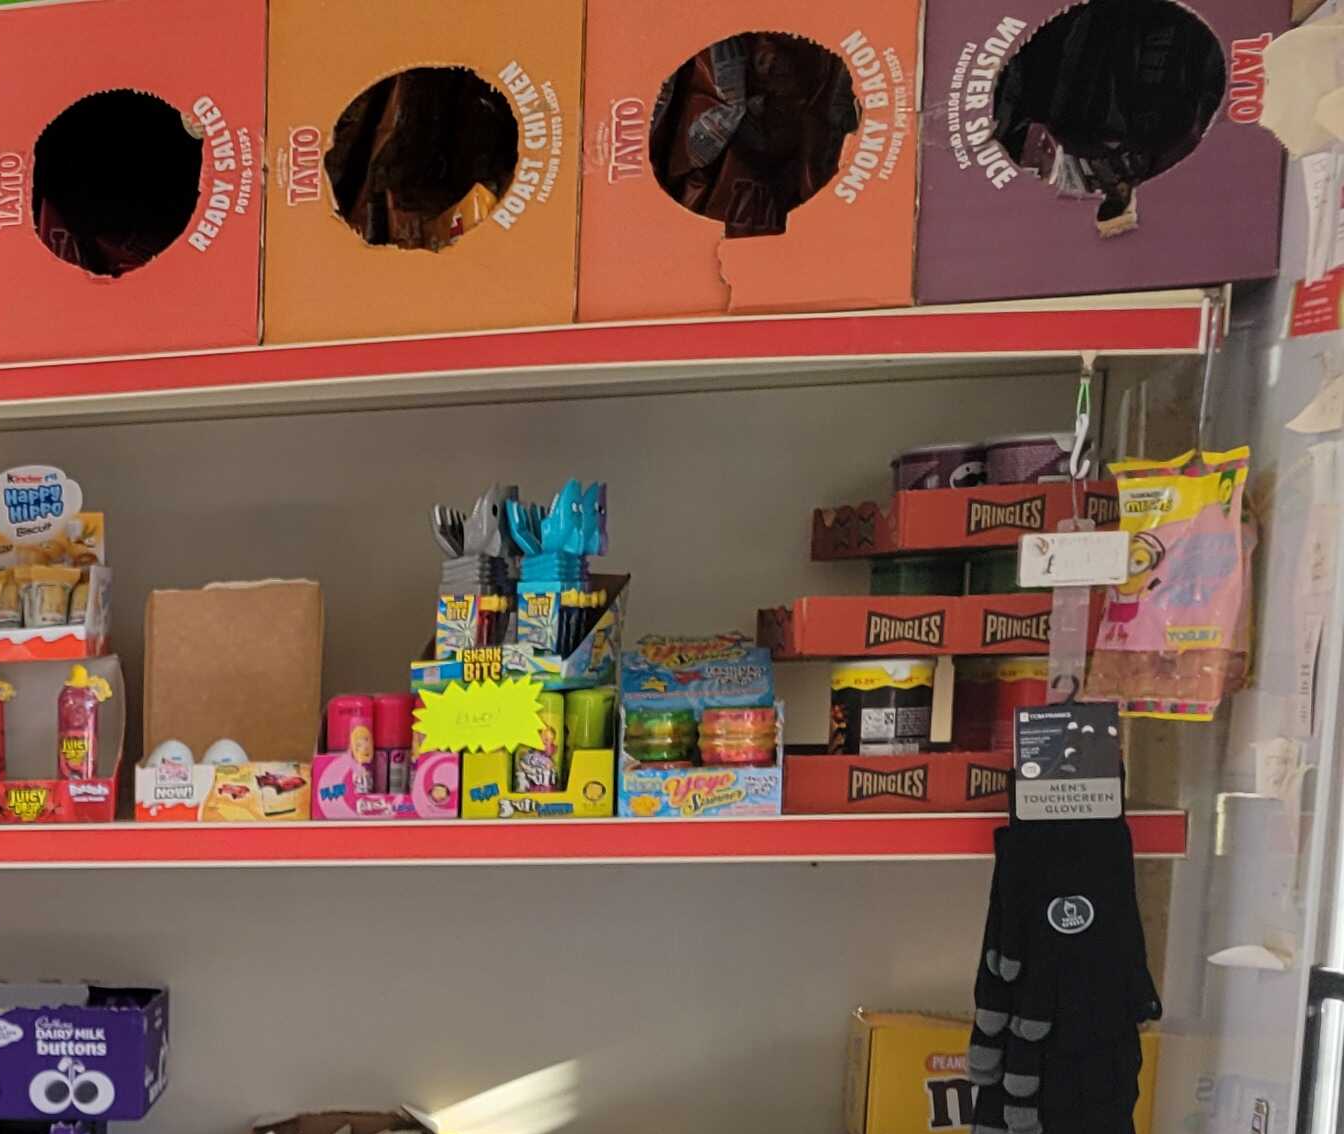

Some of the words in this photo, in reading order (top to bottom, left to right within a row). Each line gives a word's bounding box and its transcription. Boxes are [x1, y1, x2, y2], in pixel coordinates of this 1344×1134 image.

[840, 30, 890, 111] BACON
[964, 15, 1028, 113] WUSTER
[1228, 32, 1275, 125] TAYTO
[192, 95, 237, 173] SALTED
[497, 60, 547, 150] CHICKEN
[608, 97, 644, 185] TAYTO
[288, 125, 321, 207] TAYTO
[833, 117, 890, 204] SMOKY
[965, 114, 1019, 190] SAUCE
[187, 179, 234, 253] READY
[490, 155, 545, 231] ROAST
[969, 501, 1044, 530] PRINGLES
[868, 614, 942, 643] PRINGLES
[463, 662, 504, 681] BITE
[850, 769, 925, 797] PRINGLES
[1023, 793, 1114, 805] TOUCHSCREEN
[36, 1040, 107, 1056] buttons
